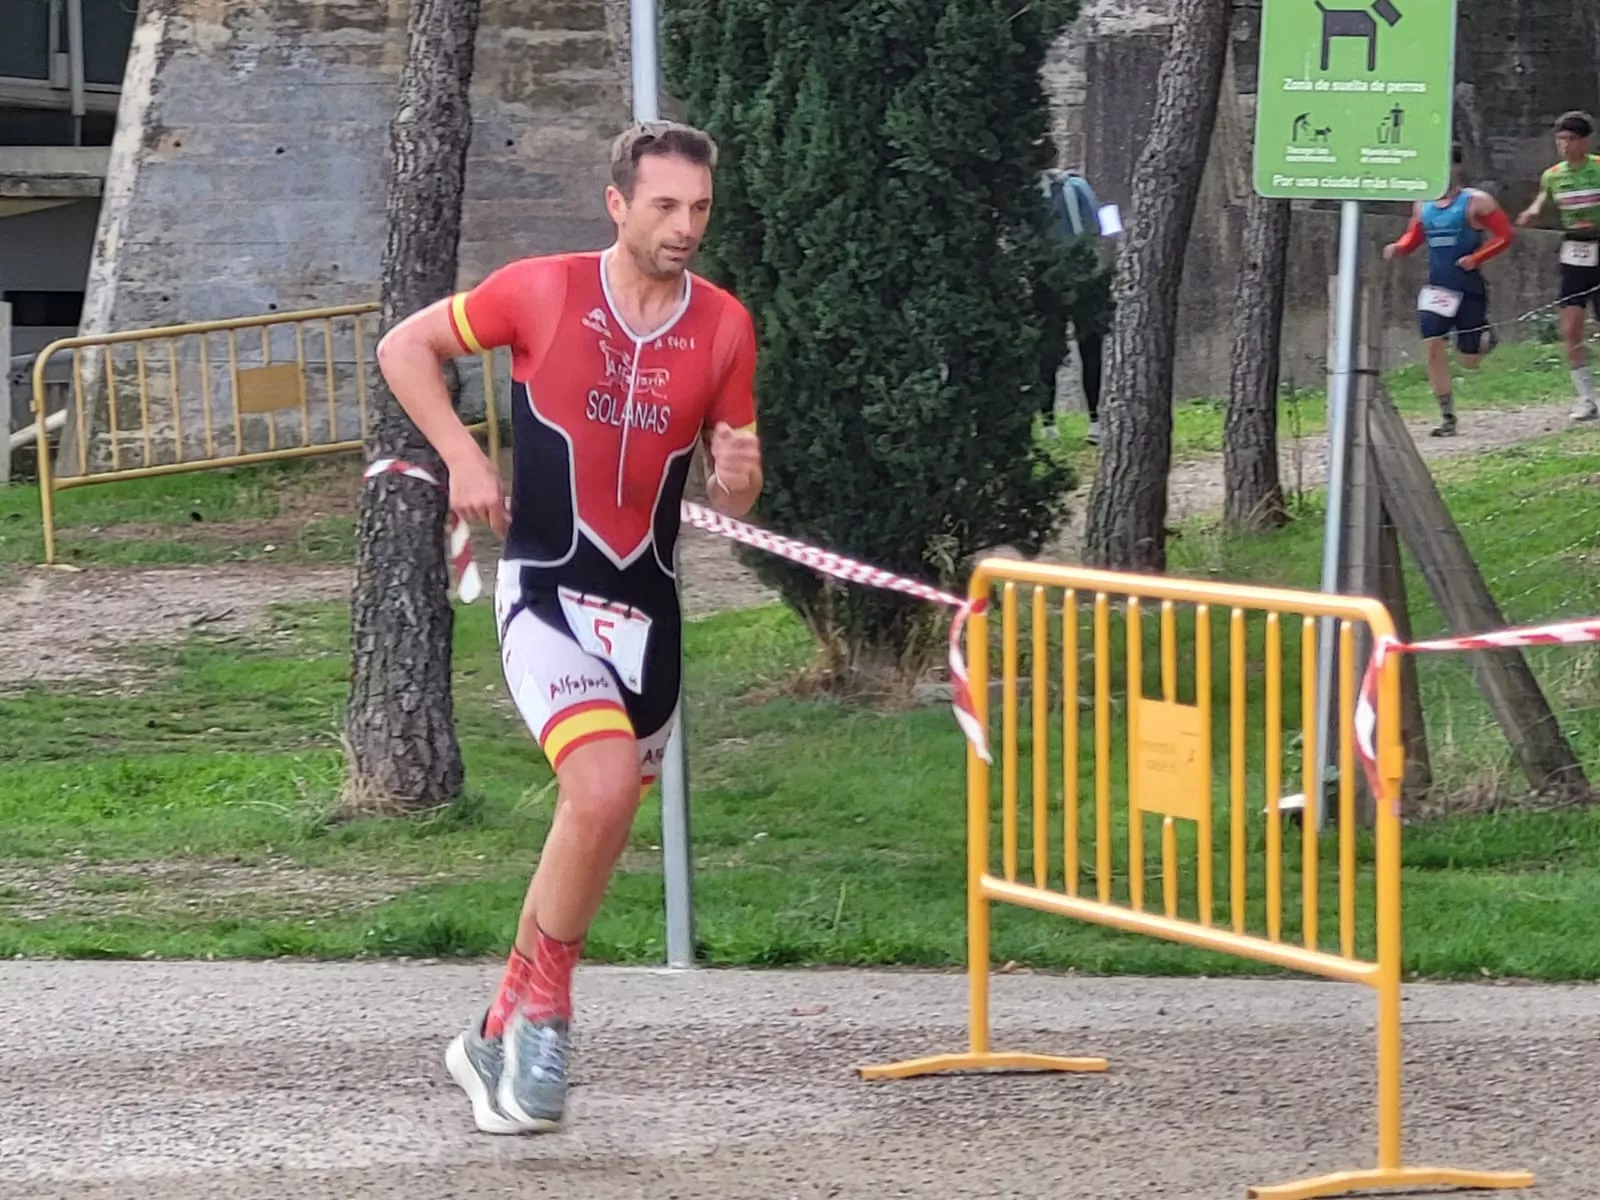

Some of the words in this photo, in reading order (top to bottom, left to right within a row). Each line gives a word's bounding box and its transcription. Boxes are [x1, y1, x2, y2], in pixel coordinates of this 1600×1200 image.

[1315, 79, 1330, 91] de
[1370, 80, 1385, 91] de
[1272, 174, 1294, 187] Por
[1320, 176, 1360, 188] ciudad
[586, 389, 670, 435] SOLANAS
[593, 618, 615, 656] 5
